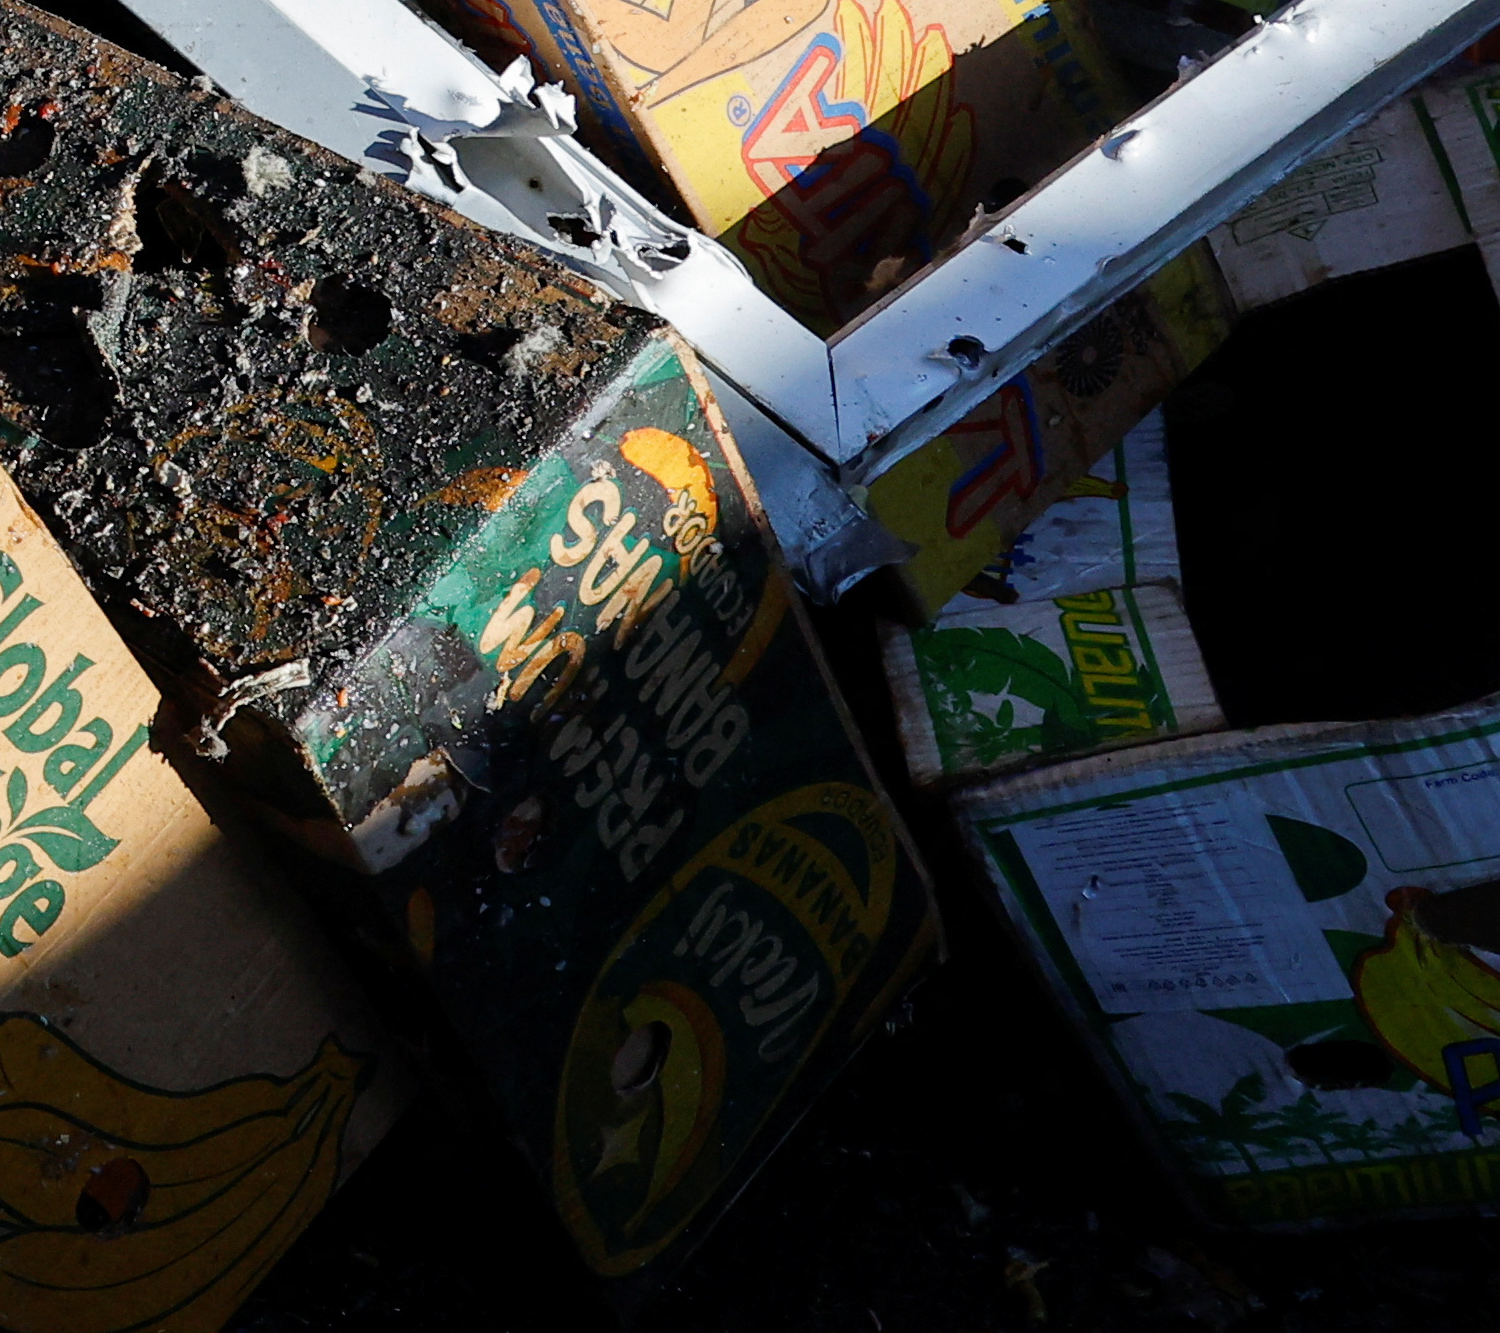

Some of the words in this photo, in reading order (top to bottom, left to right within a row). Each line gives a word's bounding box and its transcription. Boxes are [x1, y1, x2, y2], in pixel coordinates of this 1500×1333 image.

[550, 480, 750, 792] BANANAS
[661, 489, 745, 639] ECUADOR
[1055, 589, 1152, 739] QUALIT
[726, 821, 862, 977] BANANAS
[819, 786, 892, 866] ECUADOR
[672, 881, 821, 1062] Vicky
